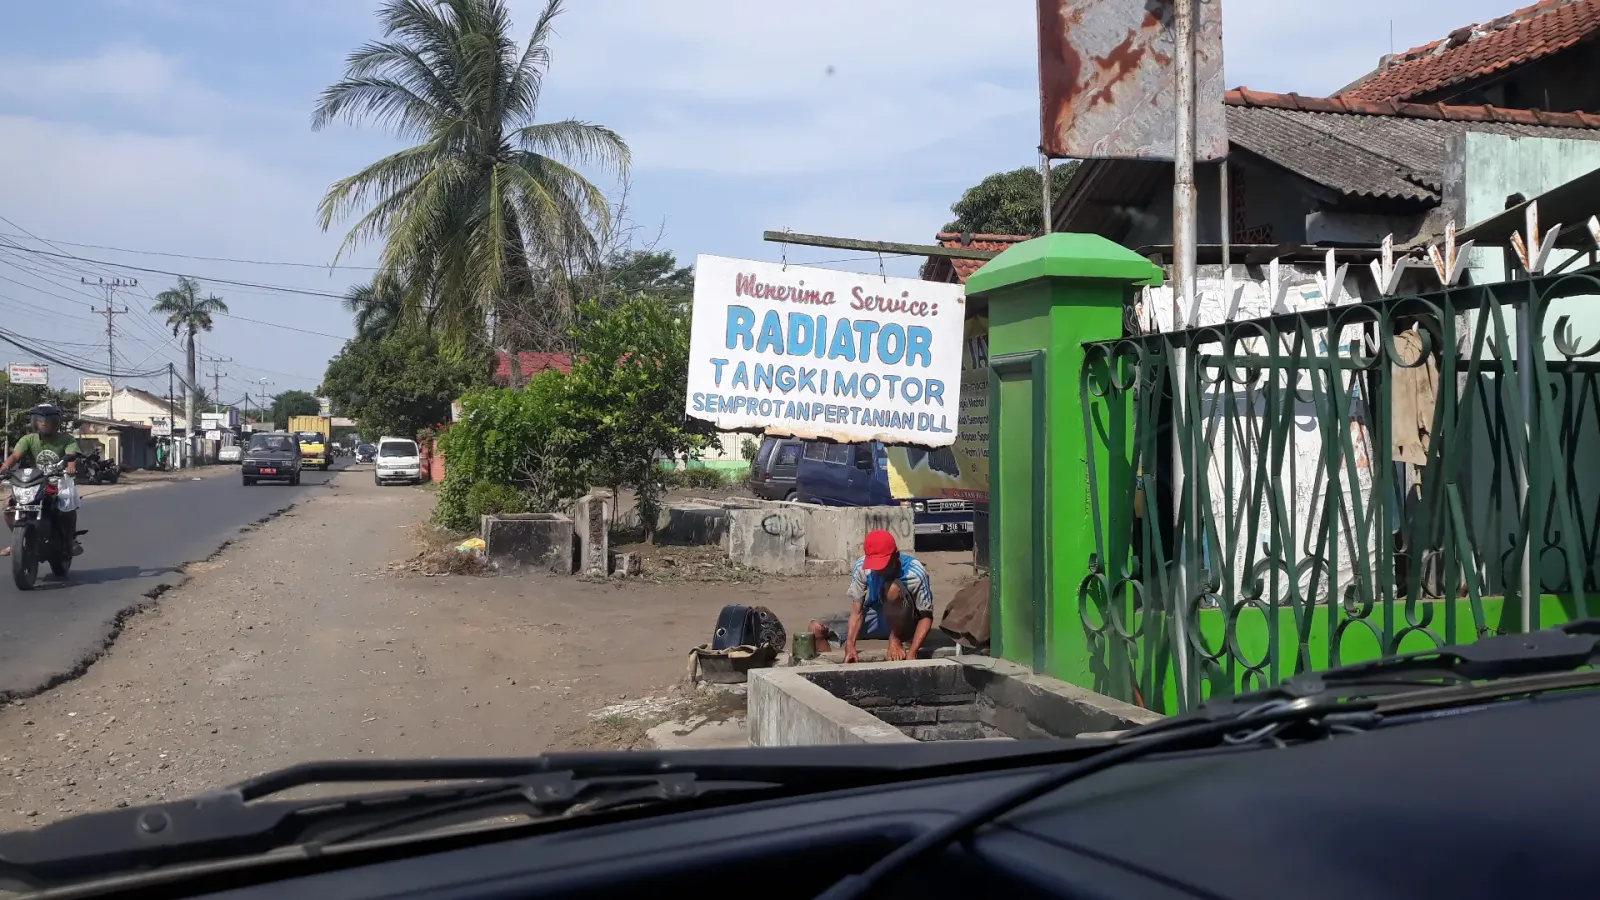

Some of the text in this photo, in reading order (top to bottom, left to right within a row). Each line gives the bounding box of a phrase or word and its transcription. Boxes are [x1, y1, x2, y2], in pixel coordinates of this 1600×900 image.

[735, 272, 938, 317] Menerima Service:
[725, 304, 932, 368] RADIATOR
